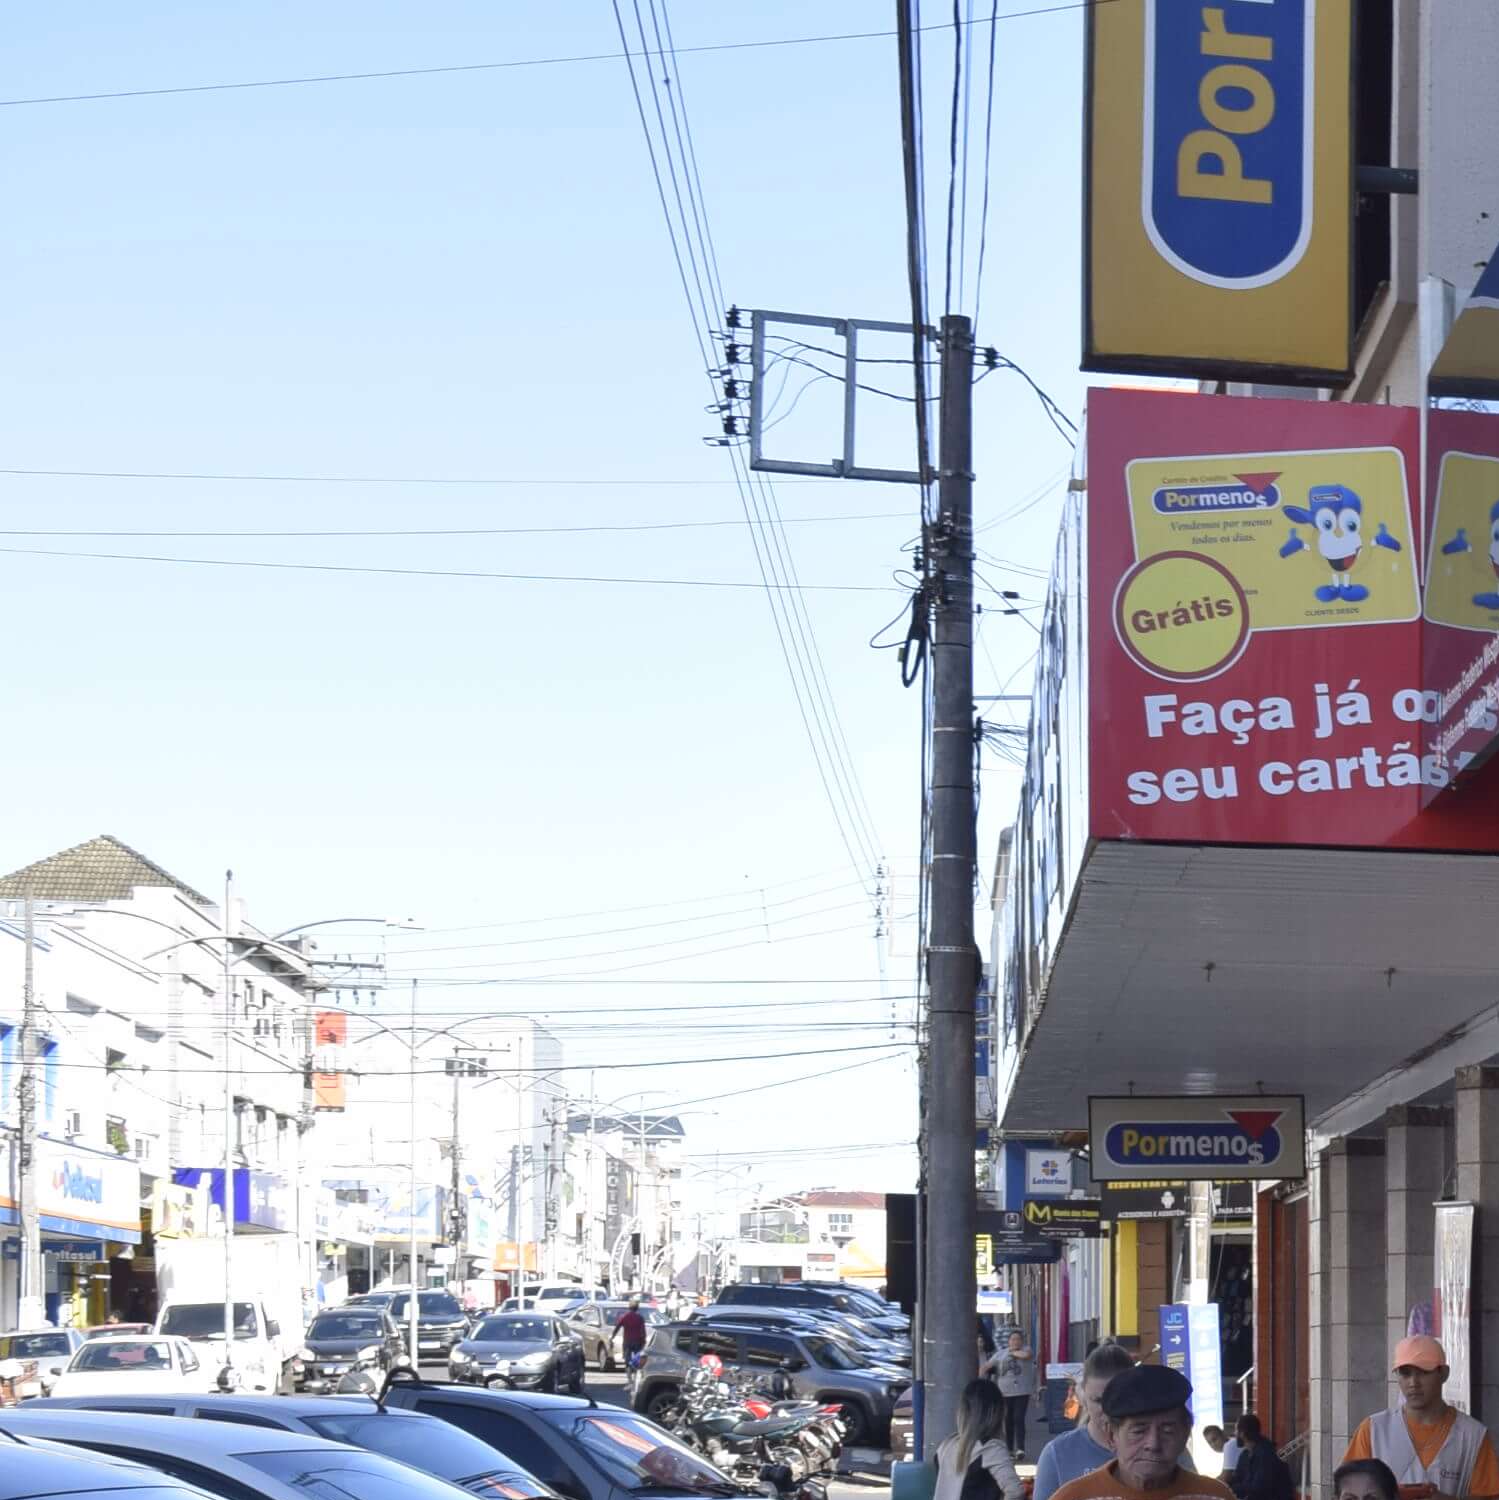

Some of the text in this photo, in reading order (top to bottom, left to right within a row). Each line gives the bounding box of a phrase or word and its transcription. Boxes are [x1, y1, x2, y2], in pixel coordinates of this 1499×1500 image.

[1177, 0, 1275, 204] Por
[1131, 597, 1234, 633] Grátis
[1144, 692, 1295, 745] Faça
[1314, 679, 1372, 738] já
[1126, 741, 1422, 806] seu cartã
